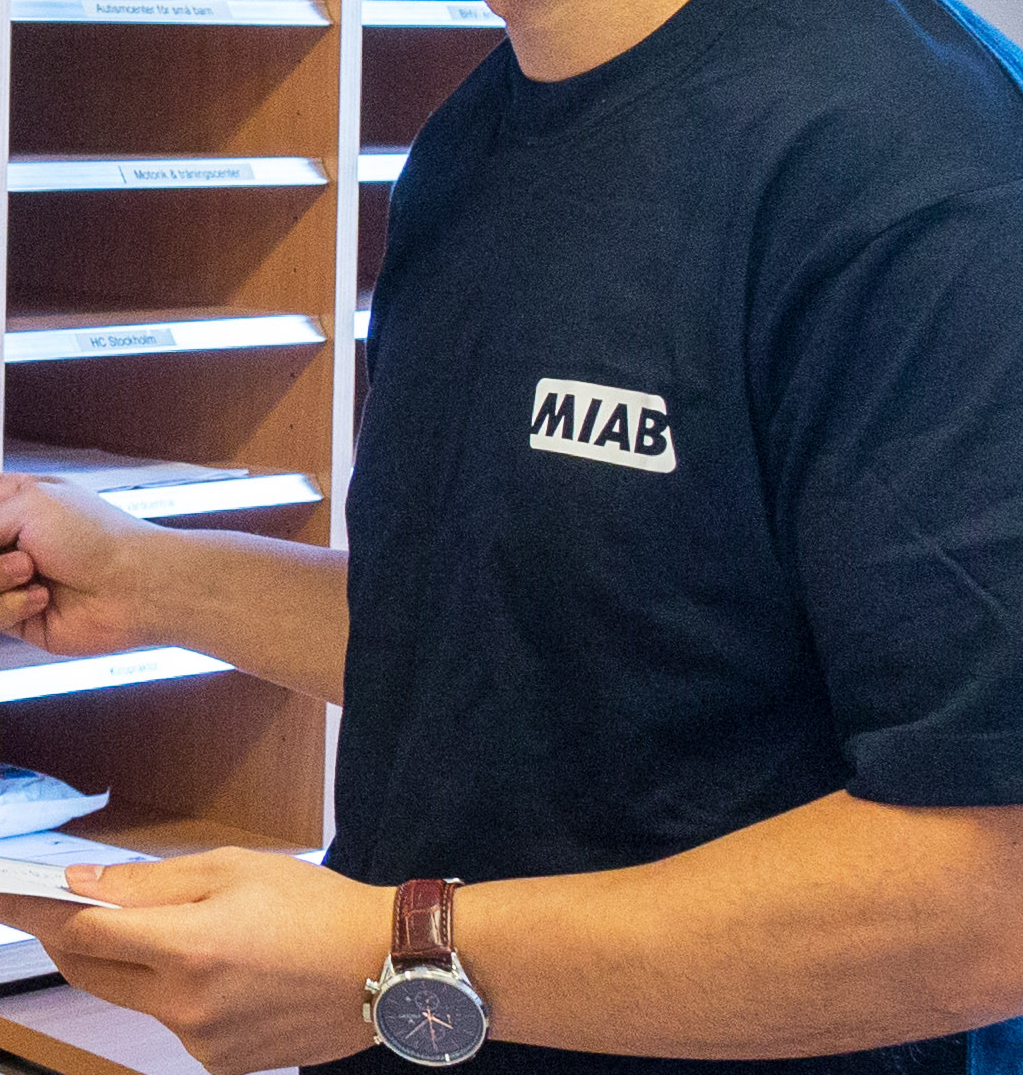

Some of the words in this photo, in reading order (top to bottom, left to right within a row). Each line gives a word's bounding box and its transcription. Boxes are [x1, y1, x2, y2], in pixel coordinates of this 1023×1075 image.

[90, 336, 107, 349] HC
[108, 334, 157, 348] Stockholm
[530, 392, 670, 456] MIAB
